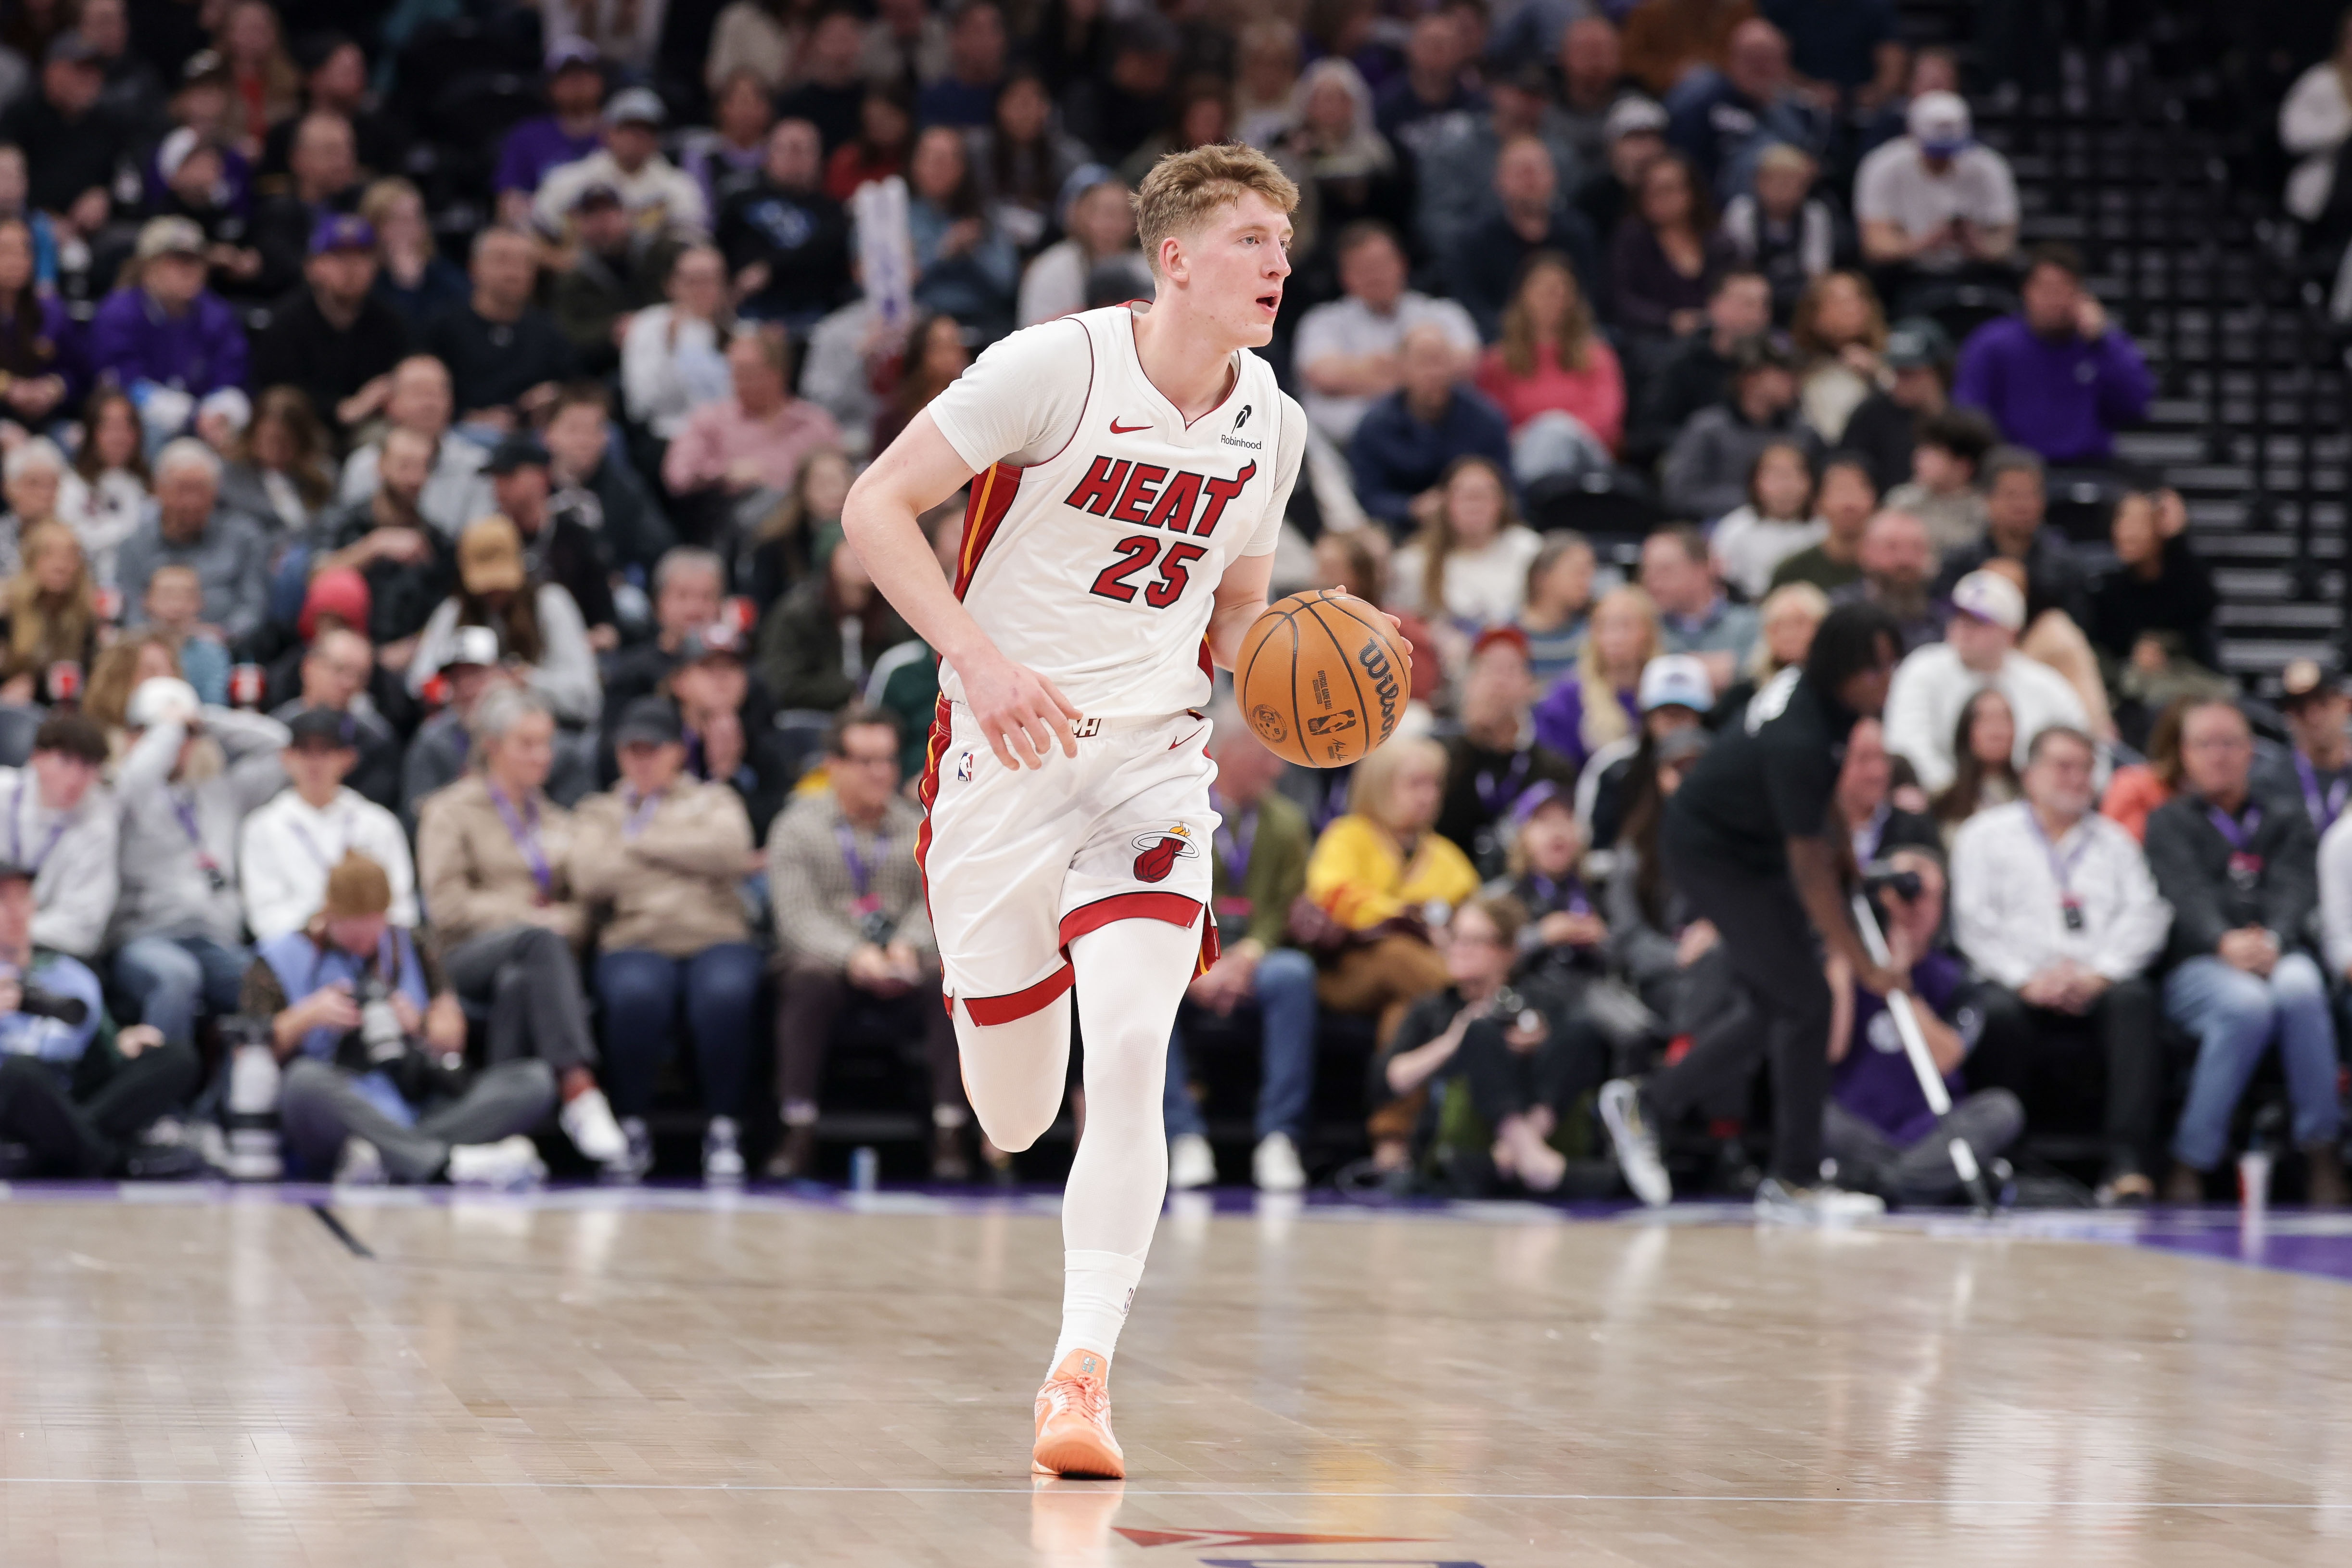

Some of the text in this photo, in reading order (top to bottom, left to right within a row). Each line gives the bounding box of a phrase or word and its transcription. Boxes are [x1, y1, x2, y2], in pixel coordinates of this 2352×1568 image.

[1220, 434, 1261, 450] Robinhood
[1063, 455, 1257, 538] HEAT
[1089, 535, 1209, 609] 25
[1318, 670, 1328, 688] OFFICIAL
[1359, 637, 1399, 750] Wilson
